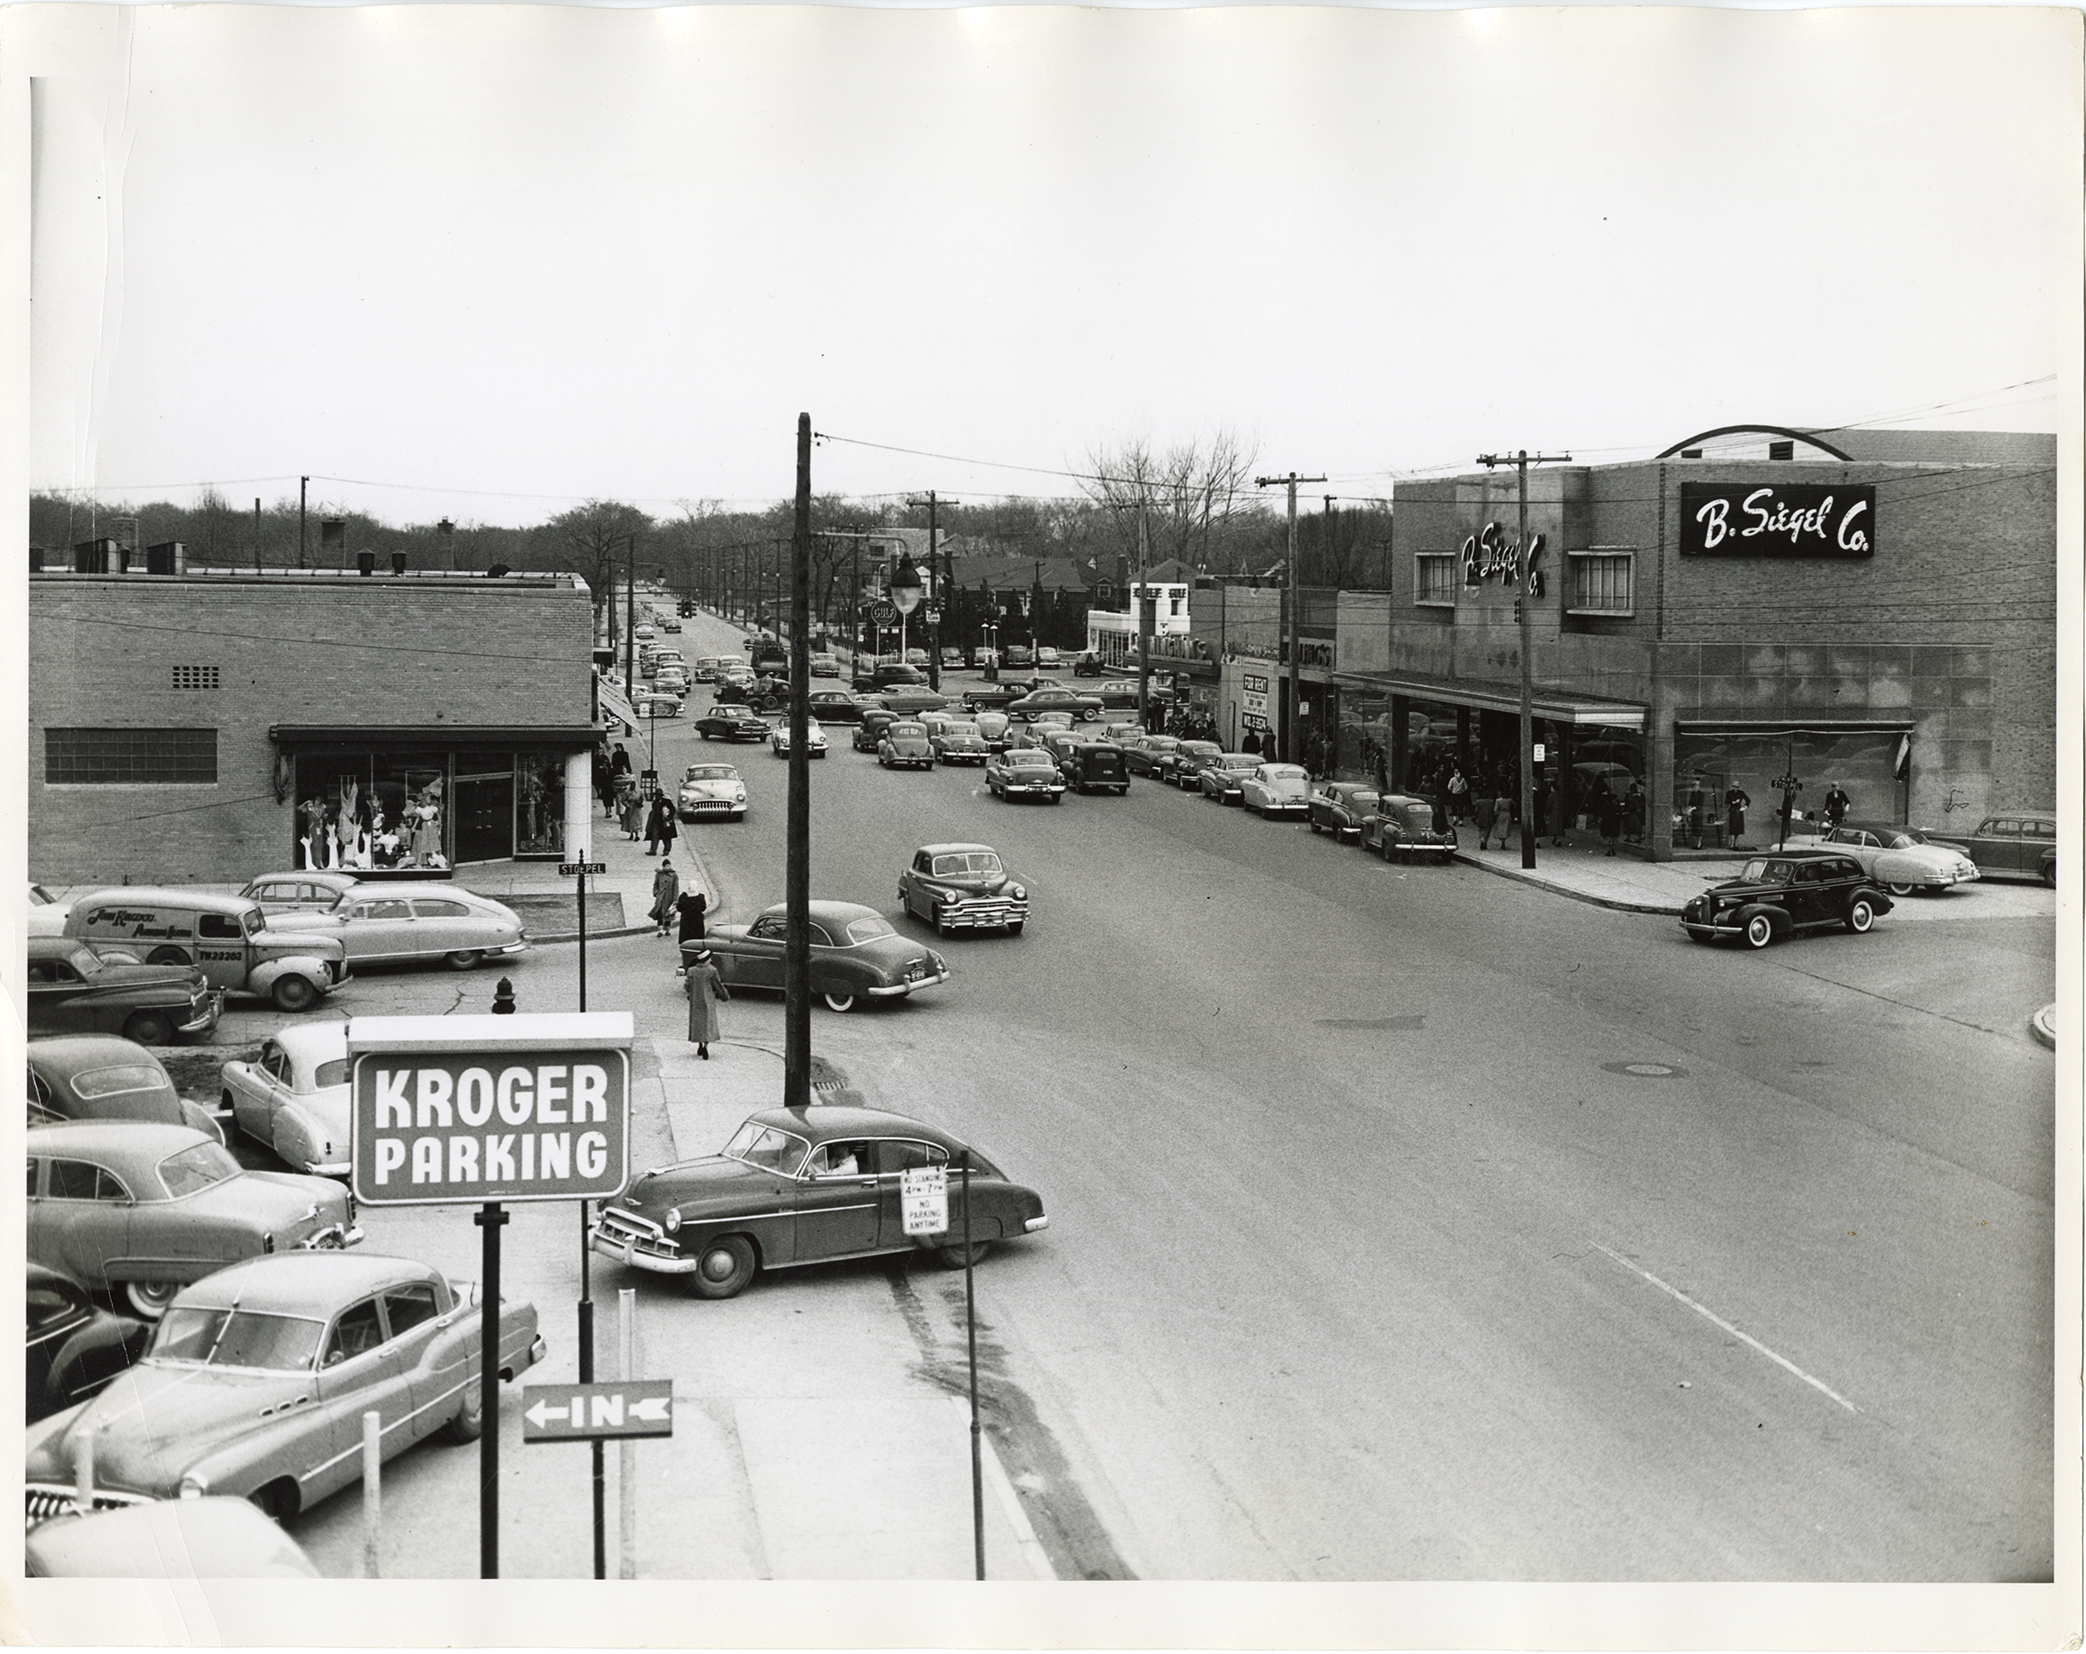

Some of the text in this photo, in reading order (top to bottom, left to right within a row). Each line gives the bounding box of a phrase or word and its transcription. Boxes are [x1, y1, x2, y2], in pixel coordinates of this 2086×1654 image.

[1696, 488, 1870, 552] B. Siegel Co.
[874, 607, 894, 618] GULF
[562, 864, 603, 874] STOEPEL
[375, 1064, 608, 1128] KROGER
[375, 1131, 608, 1185] PARKING
[919, 1200, 930, 1208] NO
[909, 1209, 941, 1218] PARKING
[909, 1219, 941, 1229] ANYTIME
[571, 1394, 624, 1428] IN
